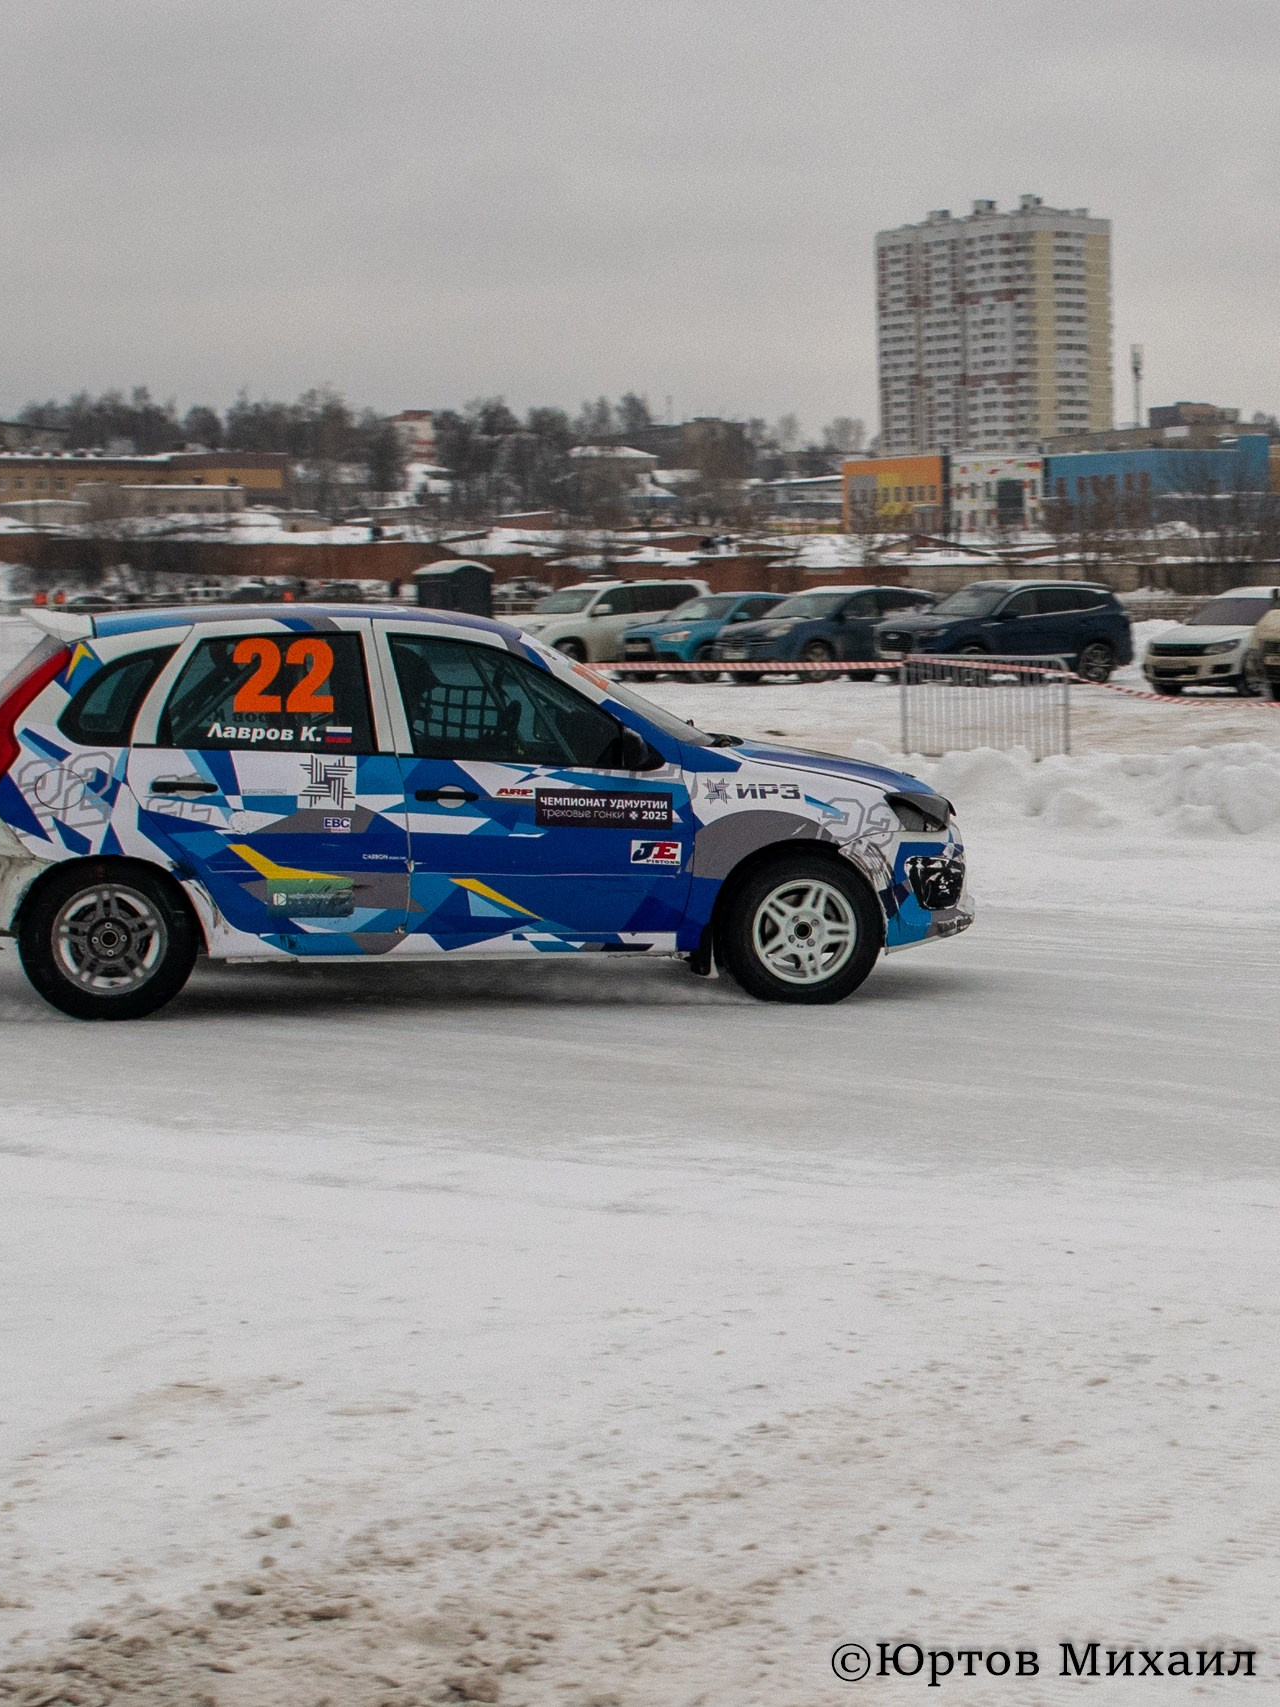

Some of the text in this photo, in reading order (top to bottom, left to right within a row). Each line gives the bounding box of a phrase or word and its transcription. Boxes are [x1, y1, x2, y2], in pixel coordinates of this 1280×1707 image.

[233, 638, 334, 712] 22
[207, 723, 322, 743] Лавров К.
[496, 788, 533, 796] ARP
[736, 783, 801, 799] ИРЗ
[540, 797, 668, 809] ЧЕМПИОНАТ УДМУРТИИ
[641, 811, 668, 820] 2025
[324, 817, 351, 828] EBC
